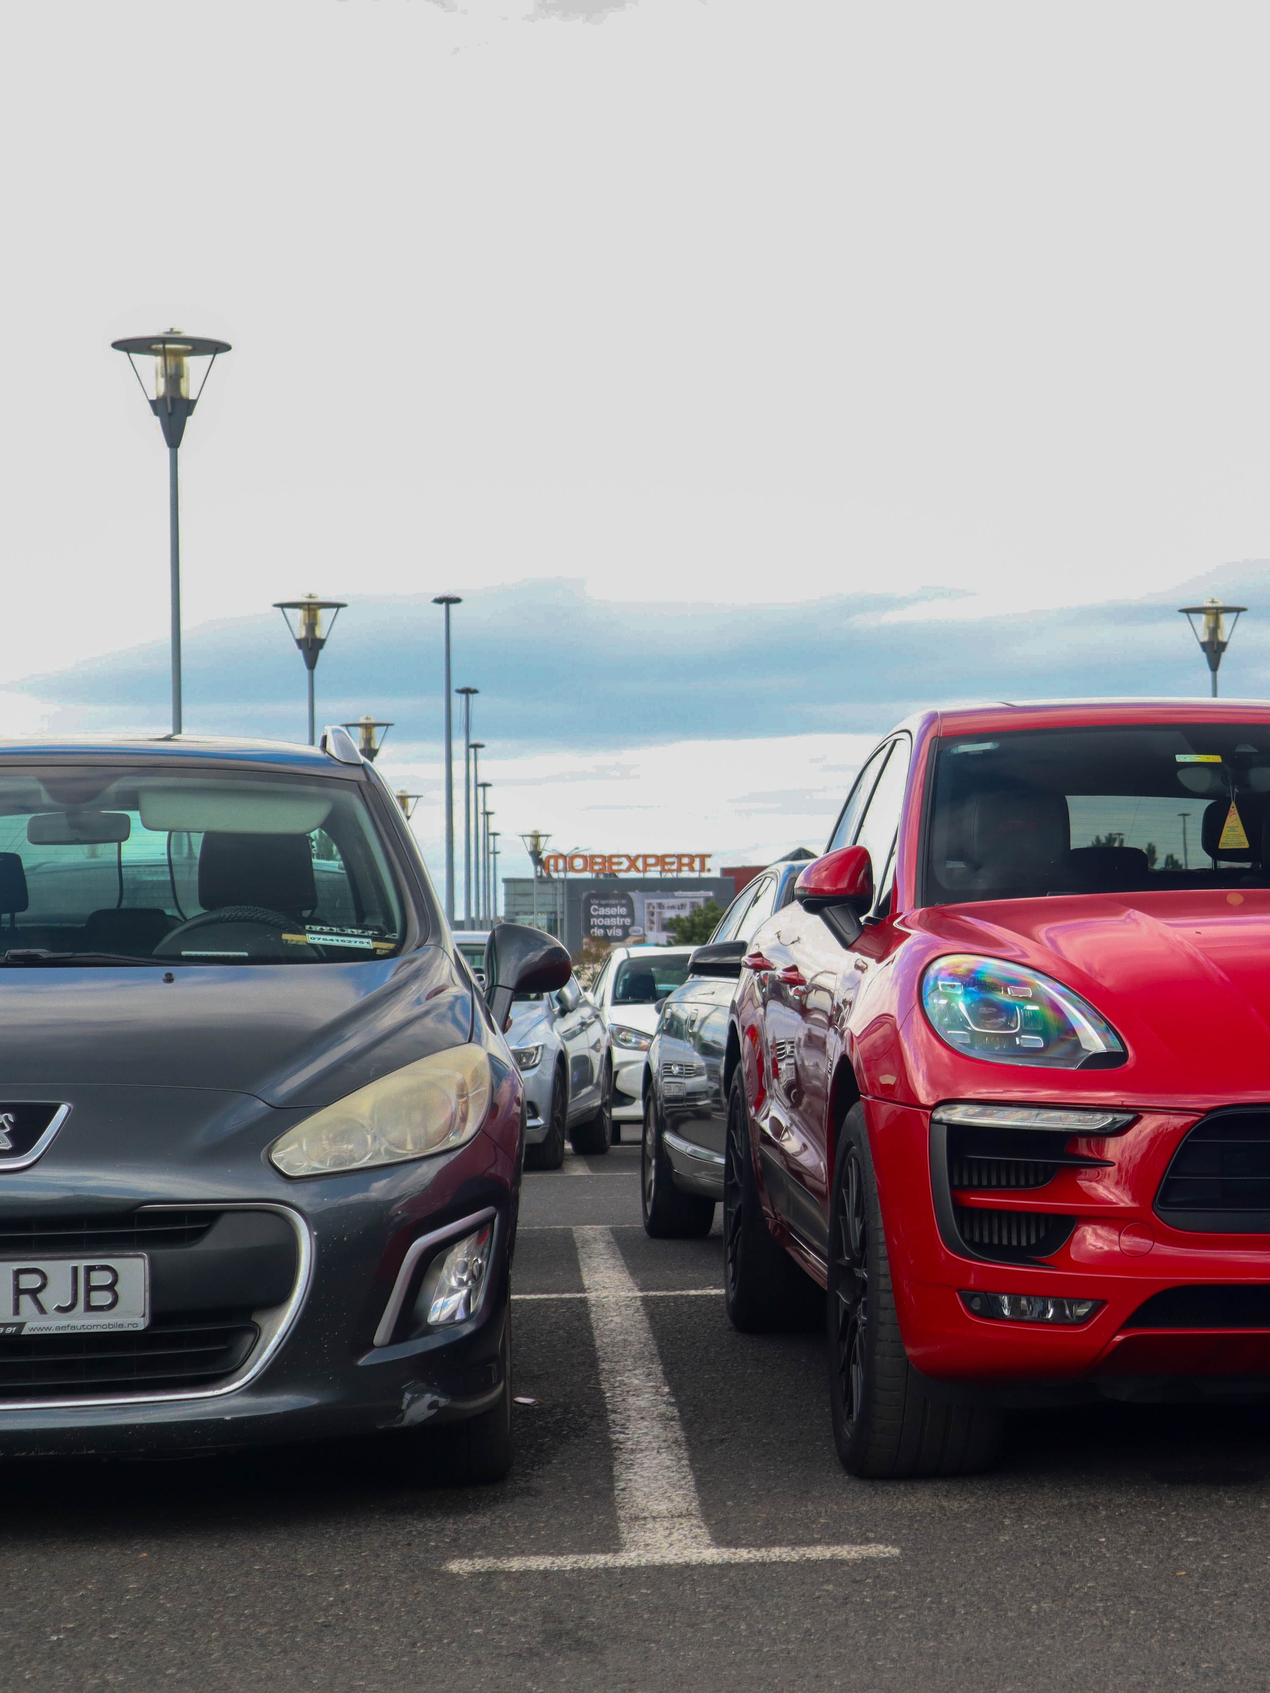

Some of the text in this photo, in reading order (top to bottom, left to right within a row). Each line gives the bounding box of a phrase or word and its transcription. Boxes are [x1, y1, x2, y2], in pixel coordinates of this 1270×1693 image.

[590, 905, 627, 915] Casele
[590, 917, 631, 926] noastre
[590, 927, 604, 936] de
[606, 927, 623, 936] vis
[12, 1264, 119, 1317] RJB
